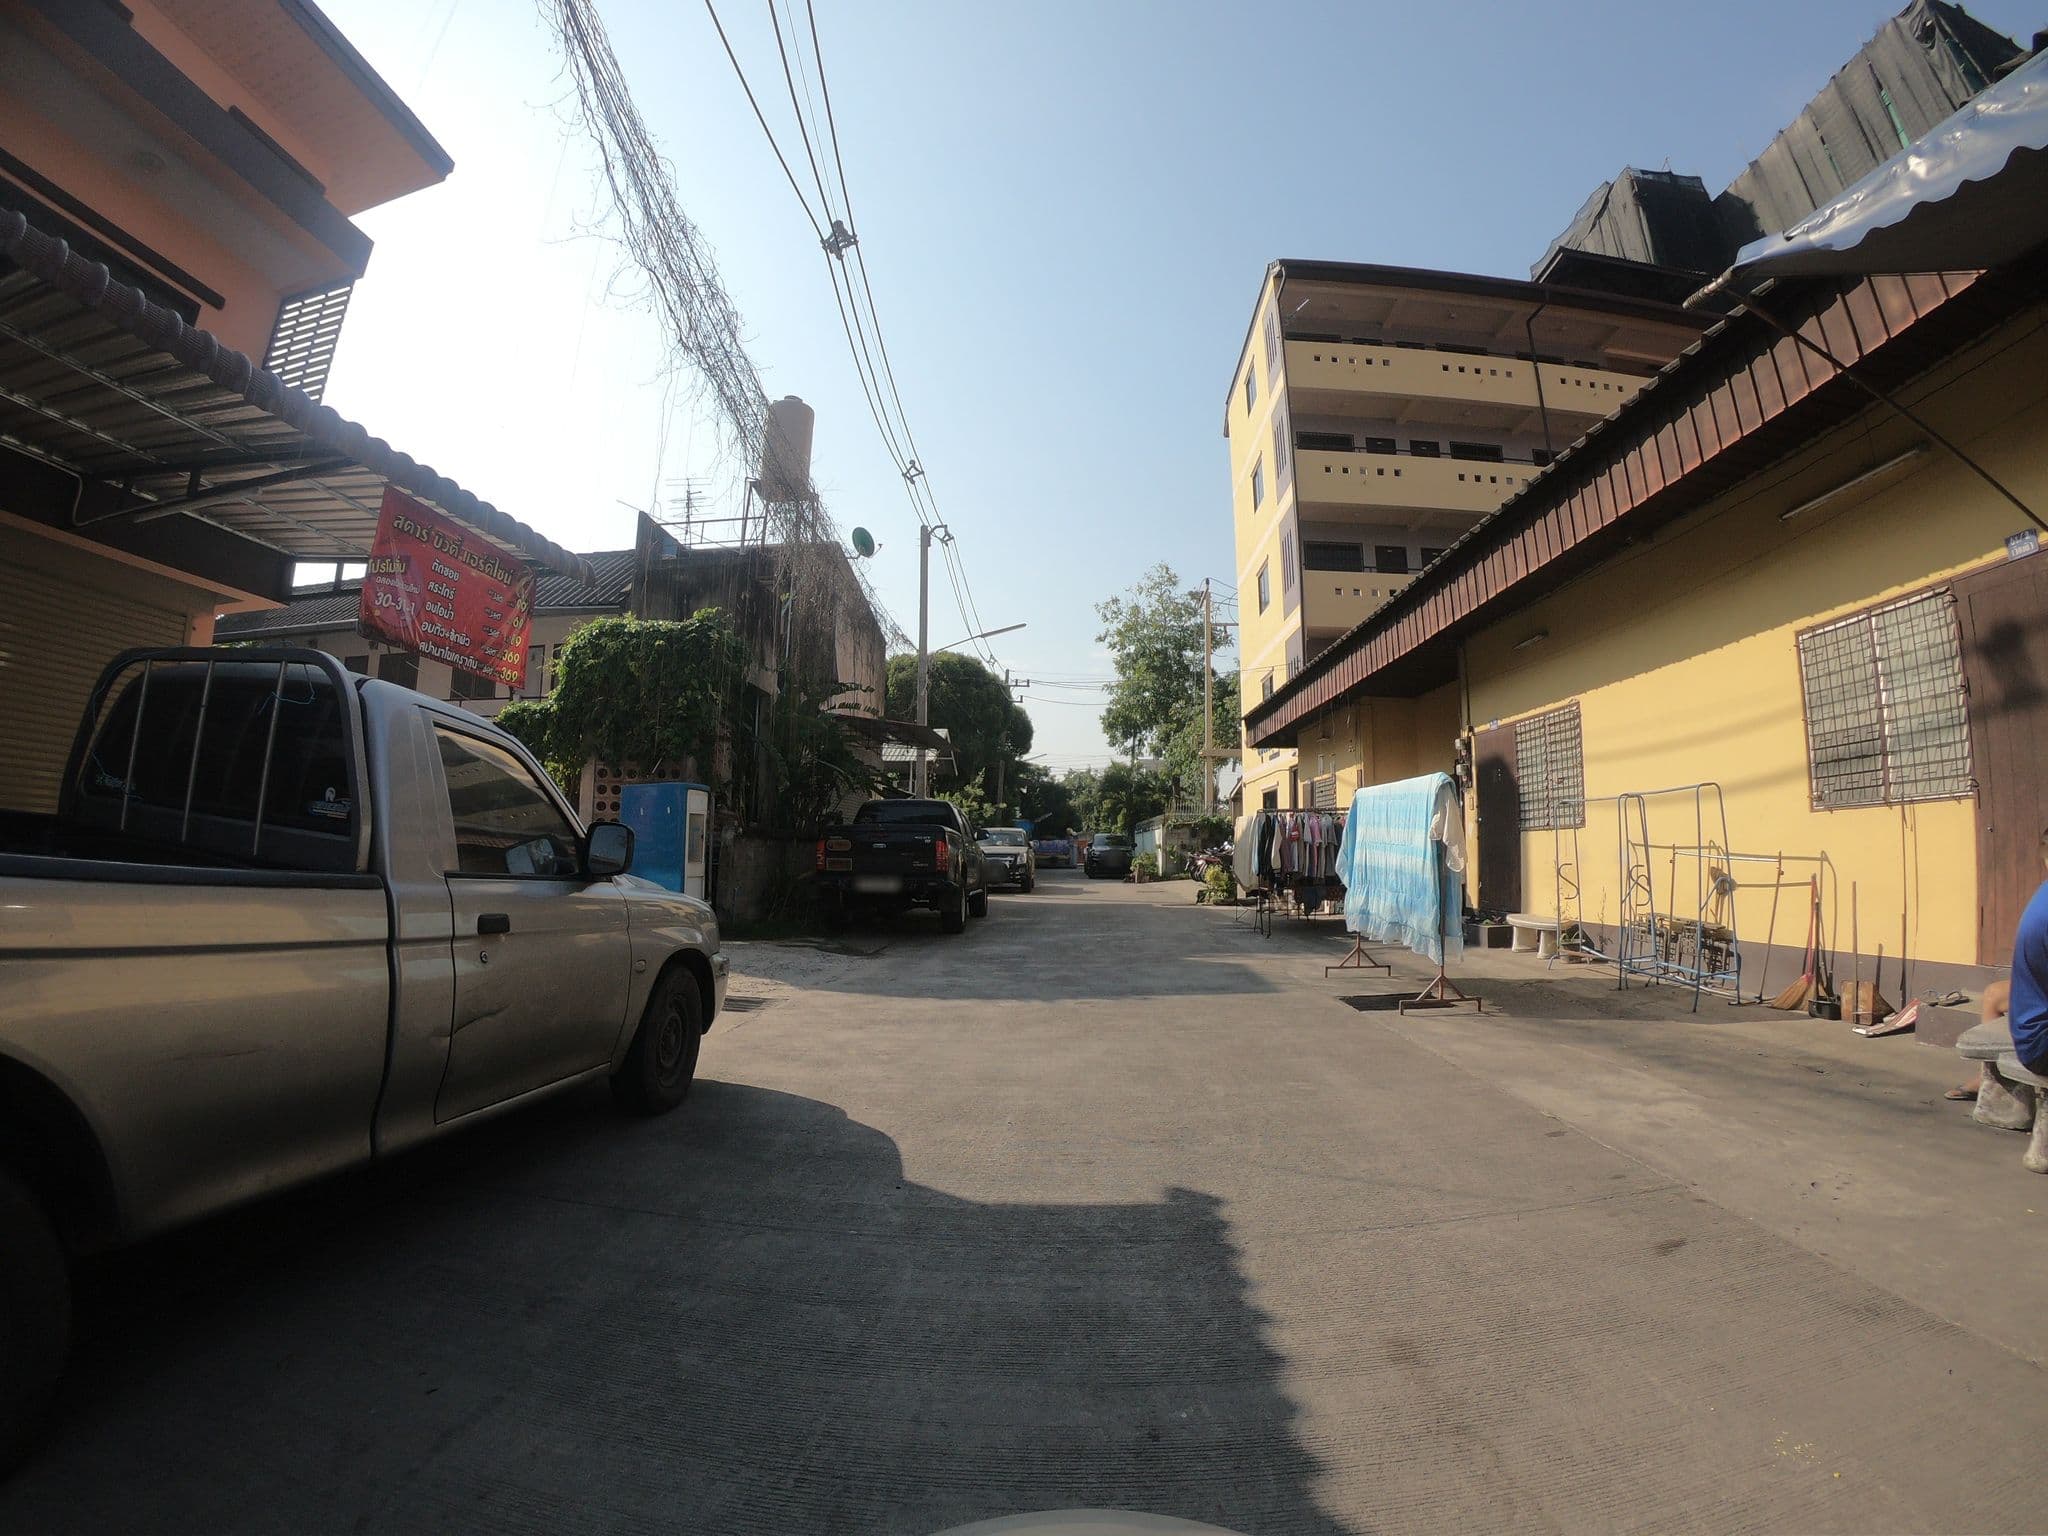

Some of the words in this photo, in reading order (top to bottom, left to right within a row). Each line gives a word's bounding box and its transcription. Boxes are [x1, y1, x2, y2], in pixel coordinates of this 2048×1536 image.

[393, 515, 431, 542] สตาร์
[434, 530, 463, 557] บิวตี้
[426, 601, 454, 621] อบไอน้ำ
[502, 648, 520, 665] 369
[500, 665, 518, 682] 369
